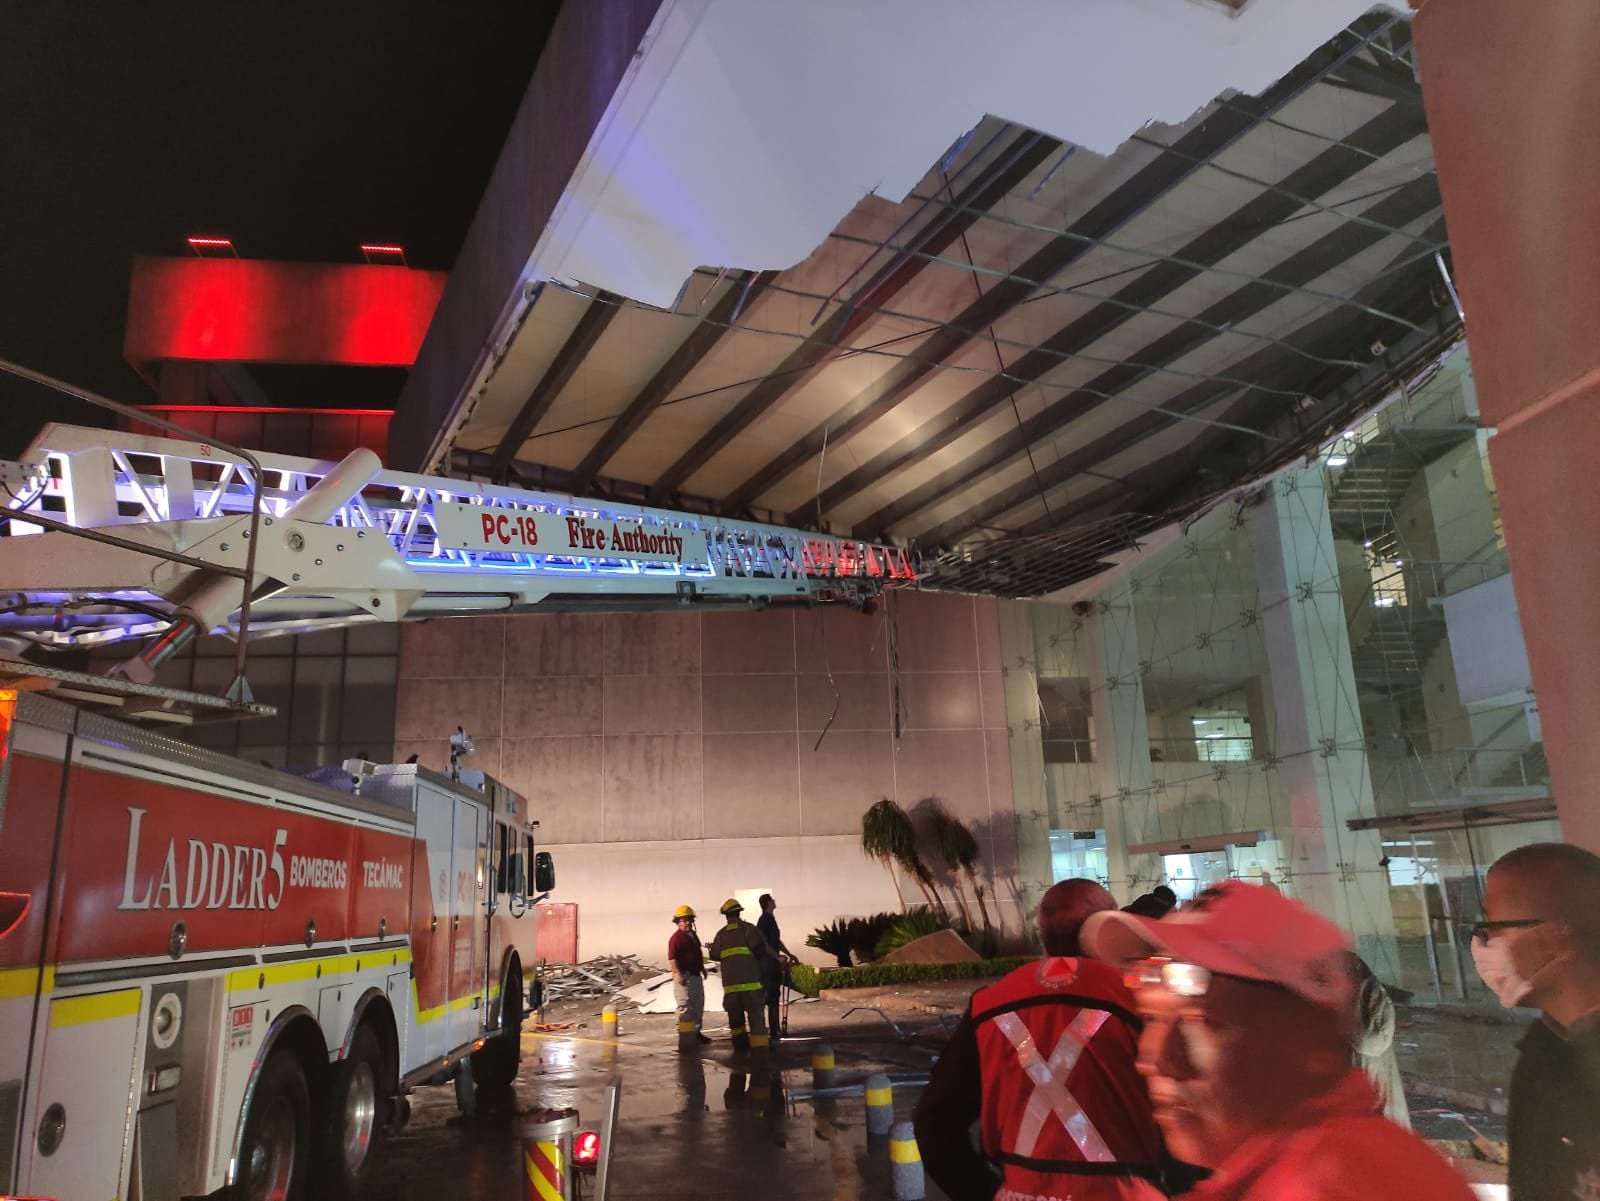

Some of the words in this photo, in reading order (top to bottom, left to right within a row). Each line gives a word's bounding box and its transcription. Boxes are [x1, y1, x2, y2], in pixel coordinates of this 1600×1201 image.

[481, 513, 538, 546] PC-18
[566, 516, 607, 549] Fire
[611, 523, 683, 562] Authority
[117, 807, 267, 909] LADDER
[289, 855, 347, 889] BOMBEROS
[363, 856, 403, 888] TECÁMAC
